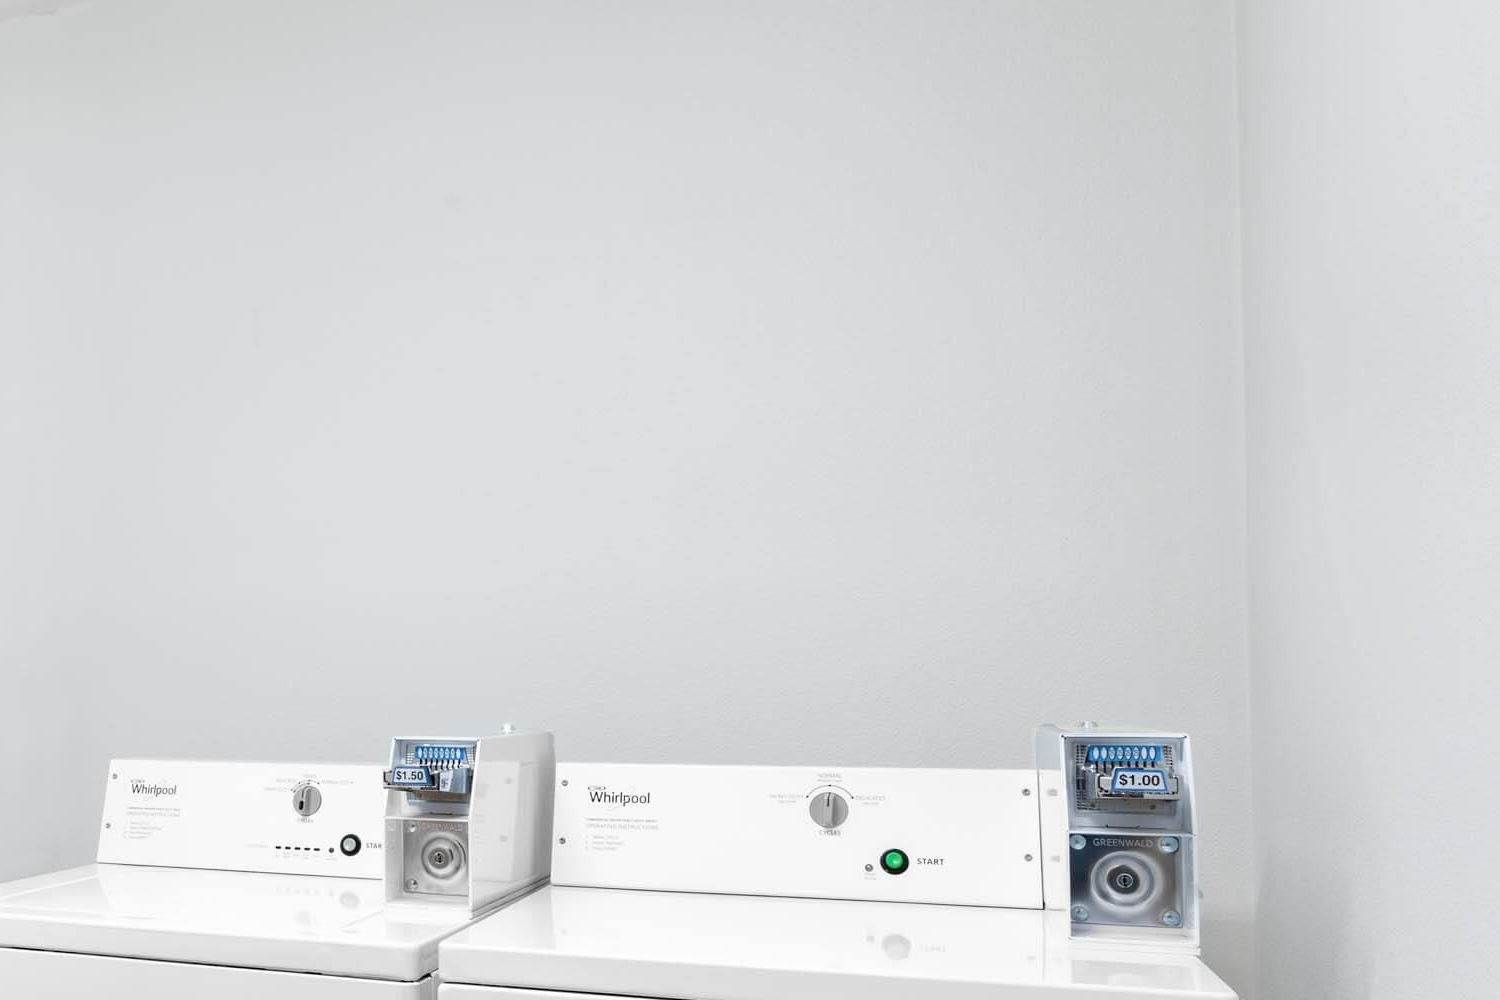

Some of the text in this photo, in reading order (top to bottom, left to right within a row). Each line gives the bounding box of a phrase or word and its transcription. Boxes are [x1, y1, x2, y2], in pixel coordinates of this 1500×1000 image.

[395, 769, 424, 781] $1.50
[1118, 773, 1161, 787] $1.00
[131, 783, 177, 798] Whirlpool
[589, 791, 651, 807] Whirlpool
[366, 842, 382, 850] STAR
[1092, 837, 1154, 848] GREENWALD
[916, 857, 945, 866] START
